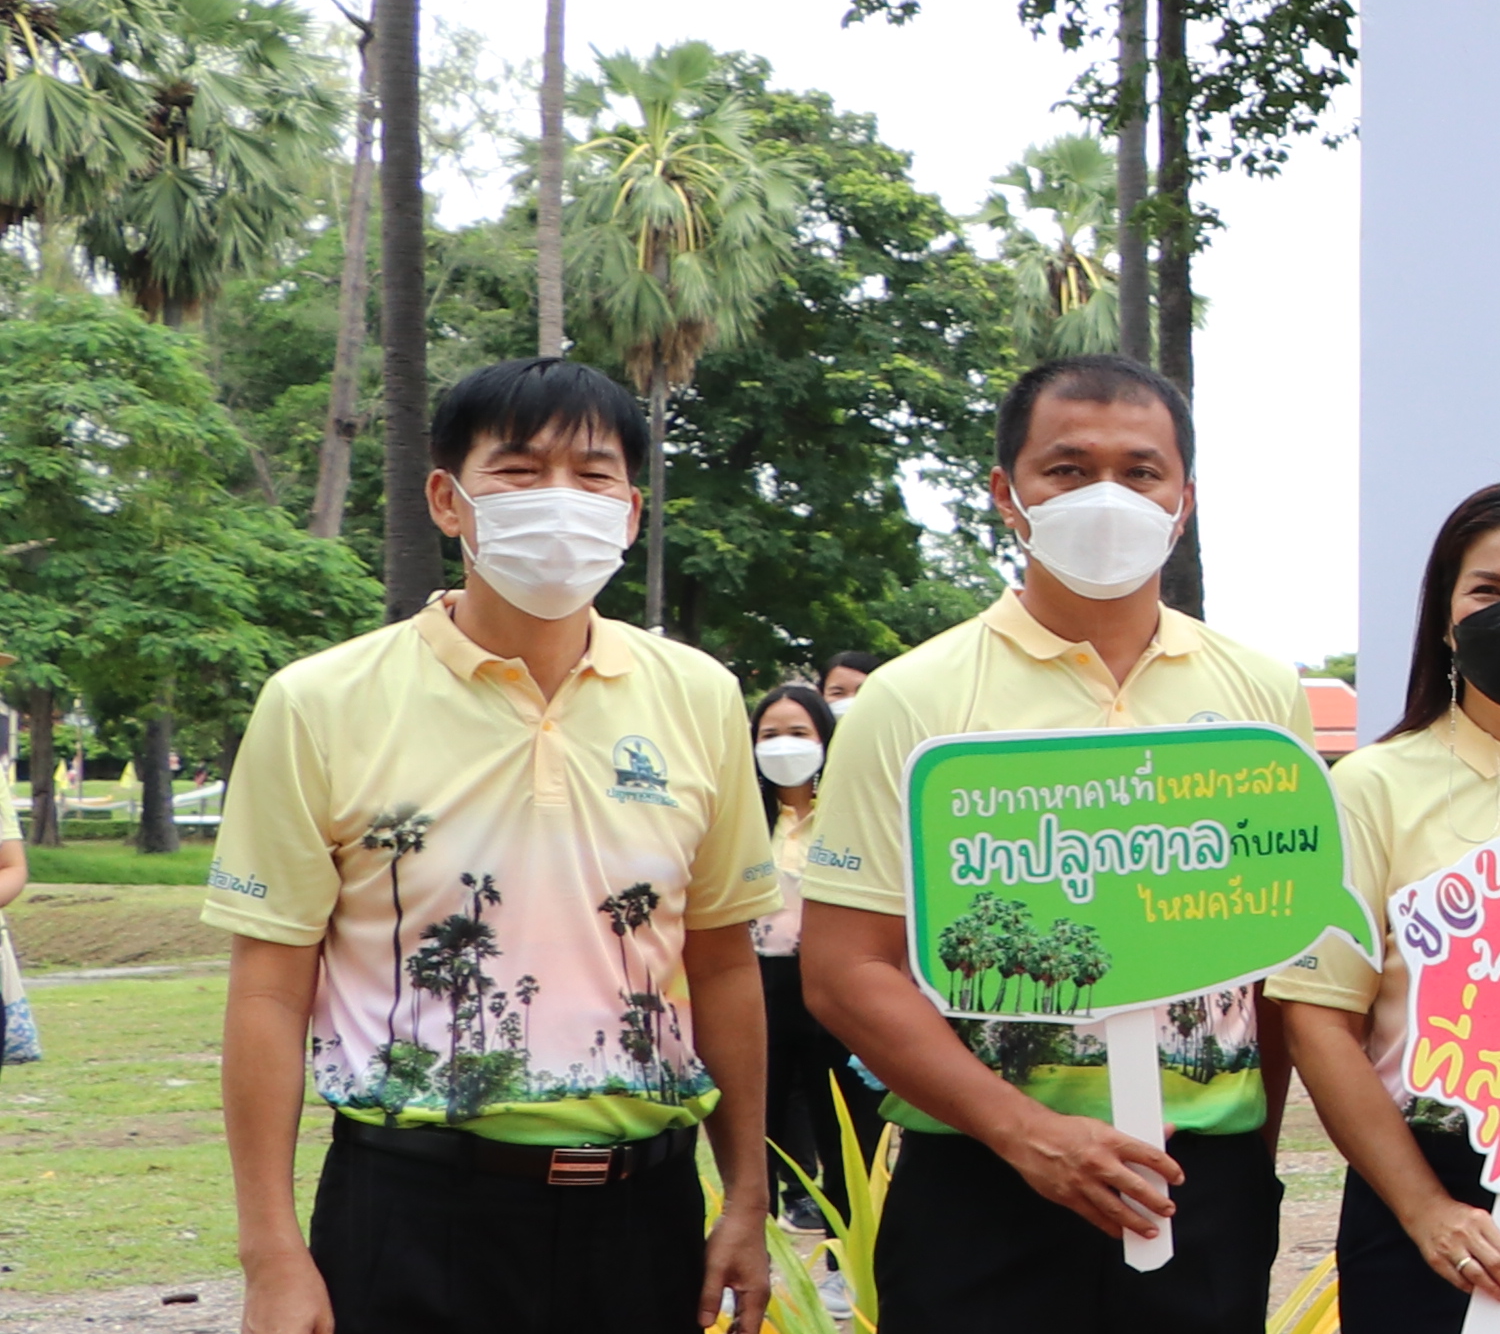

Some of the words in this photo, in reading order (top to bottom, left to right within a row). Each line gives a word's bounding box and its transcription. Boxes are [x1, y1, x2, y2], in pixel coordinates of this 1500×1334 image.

[951, 750, 1298, 817] อยากหาคนที่เหมาะสม
[950, 813, 1319, 904] มาปลูกตาลกับผม
[1138, 875, 1294, 923] ไหมครับ!!
